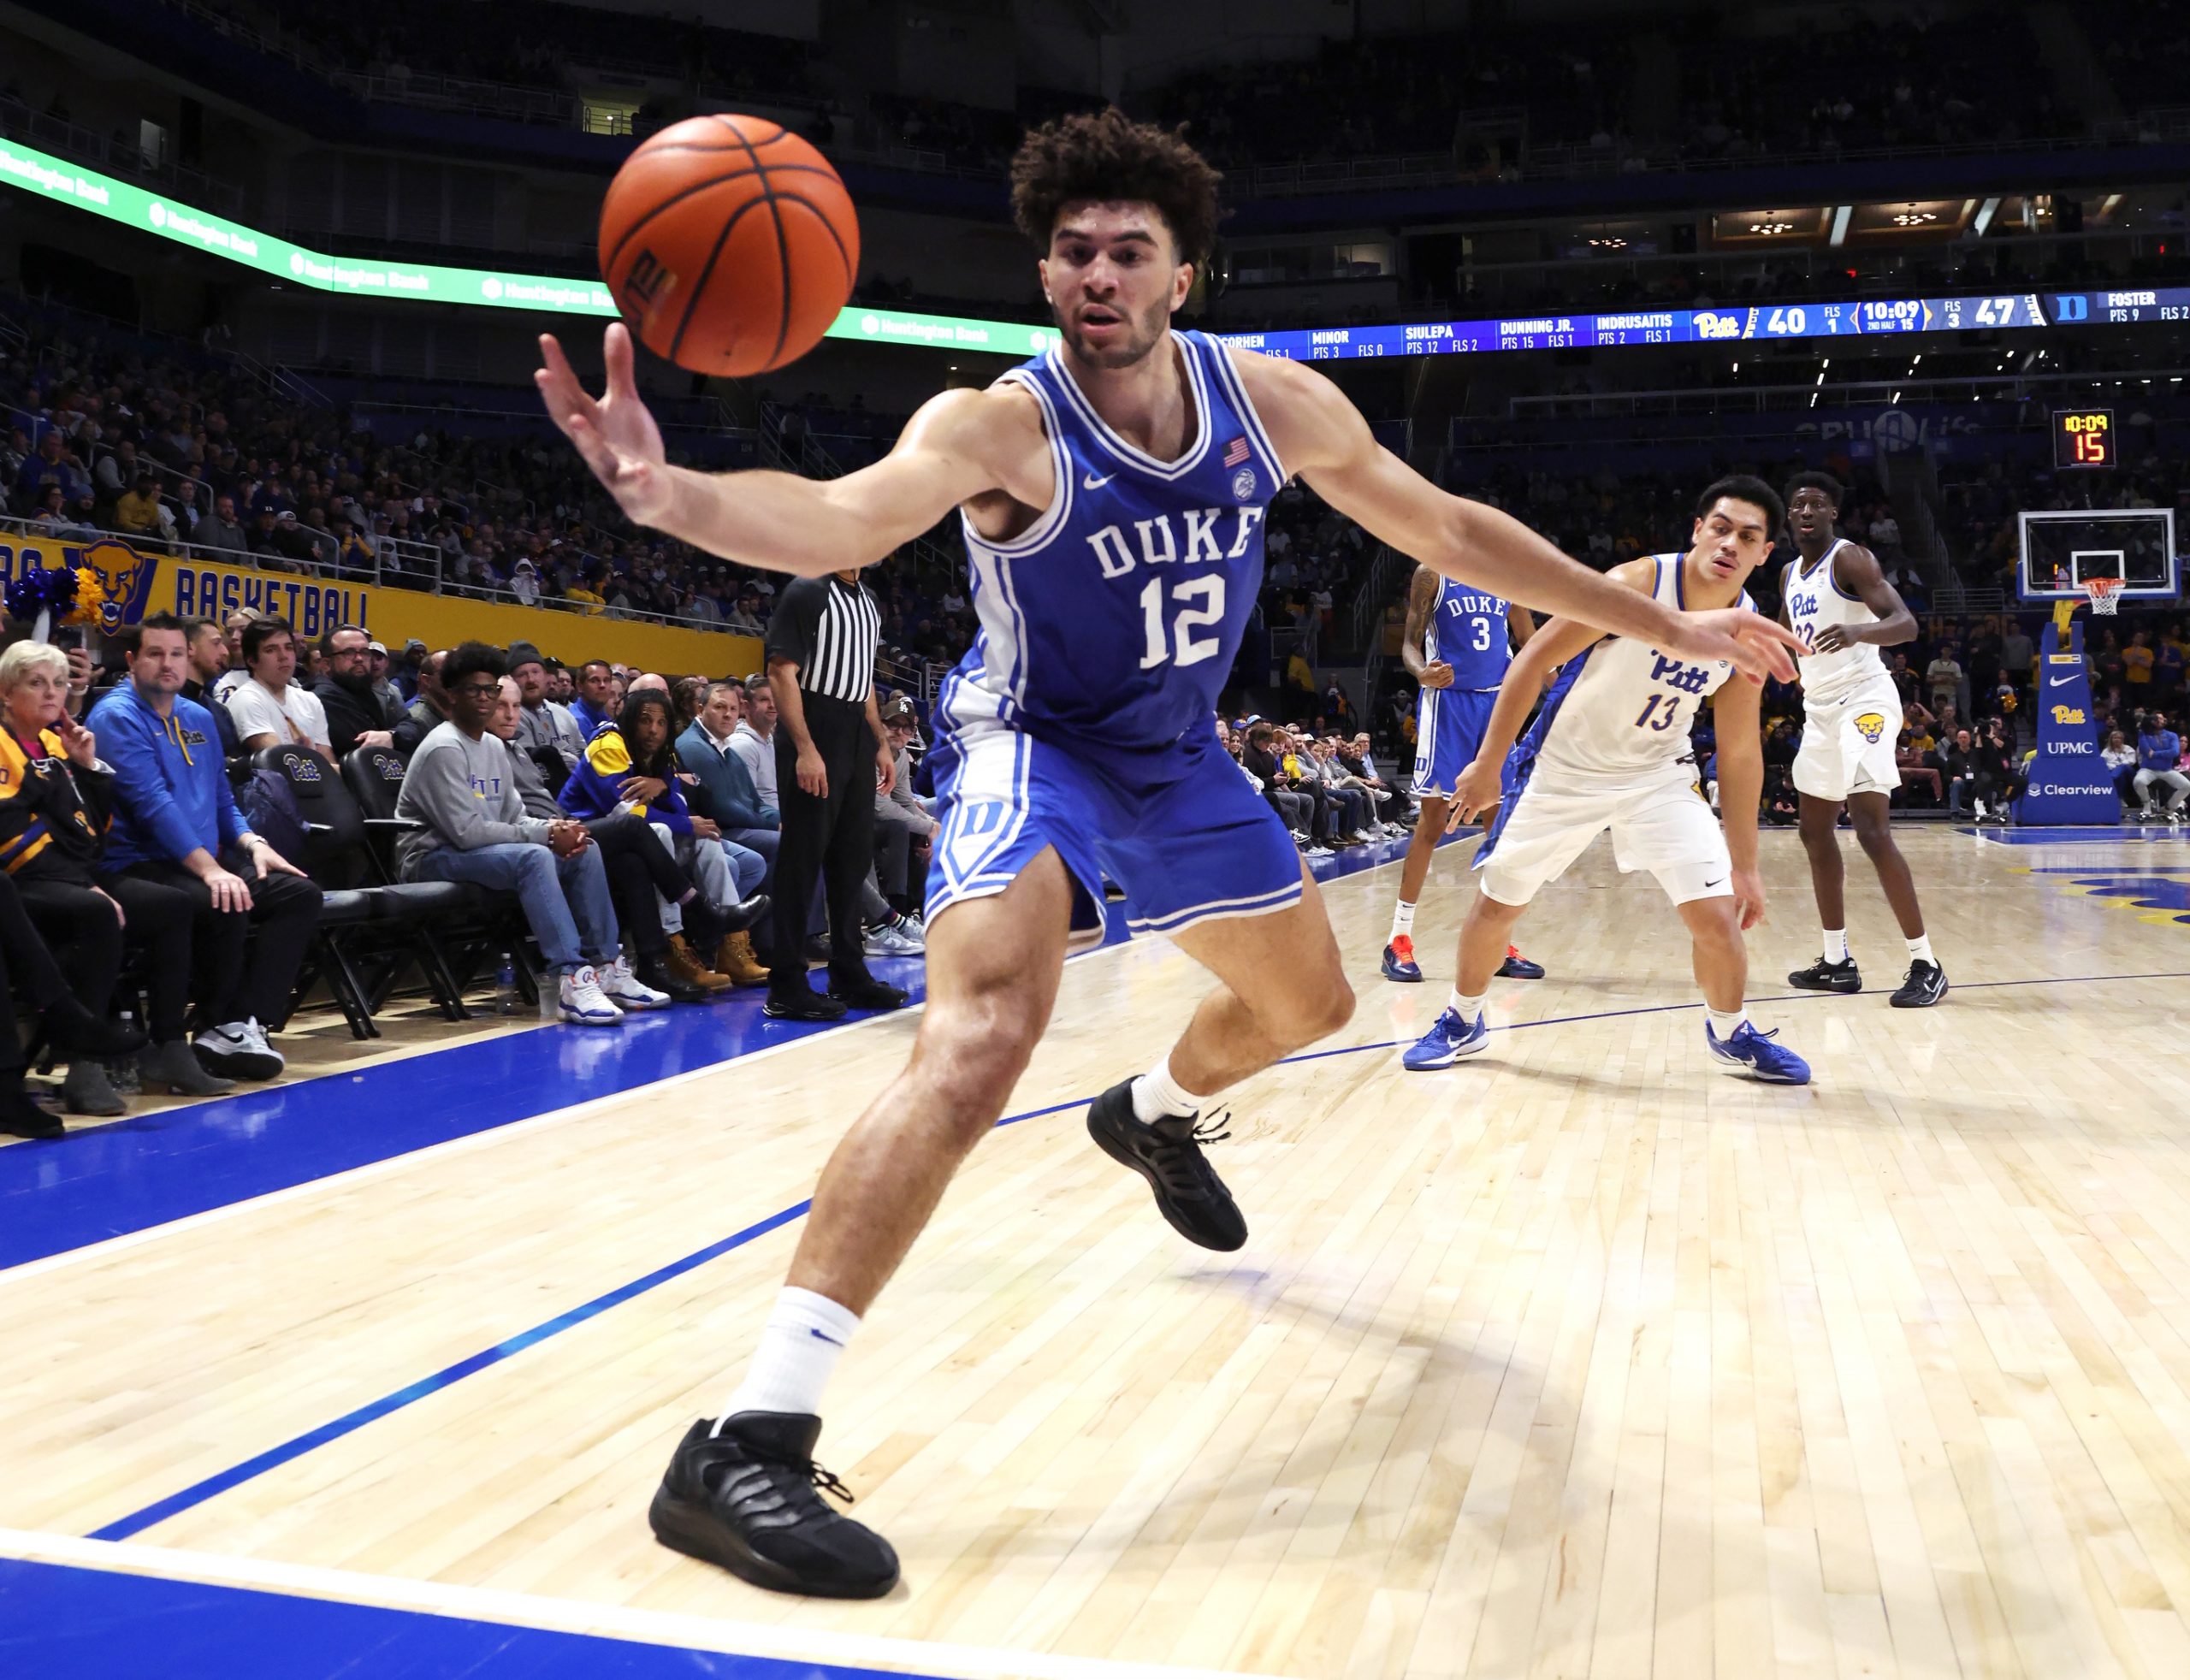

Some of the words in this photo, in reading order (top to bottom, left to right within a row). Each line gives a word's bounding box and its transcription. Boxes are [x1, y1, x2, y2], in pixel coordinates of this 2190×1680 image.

[75, 178, 110, 205] Bank
[167, 210, 228, 248] Huntington
[230, 233, 257, 257] Bank
[305, 259, 385, 287] Huntington
[388, 271, 429, 291] Bank
[505, 282, 589, 306] Huntington
[2108, 292, 2156, 307] FOSTER
[1824, 306, 1840, 318] FLS
[1864, 300, 1920, 320] 10:09
[1944, 300, 1961, 313] FLS
[1975, 298, 2015, 326] 47
[2057, 295, 2087, 322] D
[2110, 310, 2128, 322] PTS
[2132, 309, 2140, 321] 9
[2161, 307, 2179, 320] FLS
[2181, 306, 2190, 319] 2
[1500, 321, 1554, 335] DUNNING
[1555, 319, 1574, 333] JR.
[1597, 314, 1672, 330] INDRUSAITIS
[1693, 312, 1740, 339] Pitt
[1767, 308, 1806, 334] 40
[1827, 318, 1837, 334] 1
[1867, 322, 1880, 331] 2ND
[1881, 321, 1896, 330] HALF
[1900, 318, 1914, 330] 15
[1948, 313, 1960, 328] 3
[881, 319, 954, 340] Huntington
[956, 326, 988, 342] Bank
[1312, 331, 1349, 344] MINOR
[1406, 326, 1453, 340] SIULEPA
[1598, 332, 1614, 345] PTS
[1619, 331, 1625, 344] 2
[1646, 330, 1662, 342] FLS
[1666, 329, 1671, 341] 1
[1222, 335, 1264, 348] CORHEN
[1313, 346, 1329, 358] PTS
[1333, 346, 1340, 358] 3
[1358, 345, 1374, 357] FLS
[1376, 344, 1383, 356] 0
[1406, 341, 1423, 354] PTS
[1428, 340, 1438, 353] 12
[1453, 340, 1468, 352] FLS
[1471, 339, 1477, 352] 2
[1501, 337, 1518, 350] PTS
[1523, 336, 1534, 349] 15
[1548, 334, 1565, 347] FLS
[1568, 334, 1573, 346] 1
[2065, 415, 2108, 433] 10:09
[2077, 433, 2104, 460] 15
[1086, 506, 1264, 579] DUKE
[1446, 595, 1506, 617] DUKE
[1790, 593, 1818, 618] Pitt
[1139, 573, 1225, 669] 12
[1471, 617, 1490, 651] 3
[1651, 649, 1709, 694] Pitt
[899, 701, 909, 713] LA
[1635, 694, 1680, 731] 13
[2051, 705, 2086, 725] Pitt
[2047, 742, 2093, 754] UPMC
[283, 753, 322, 781] Pitt
[1414, 757, 1427, 772] D
[2045, 784, 2113, 796] Clearview
[958, 802, 1004, 839] D
